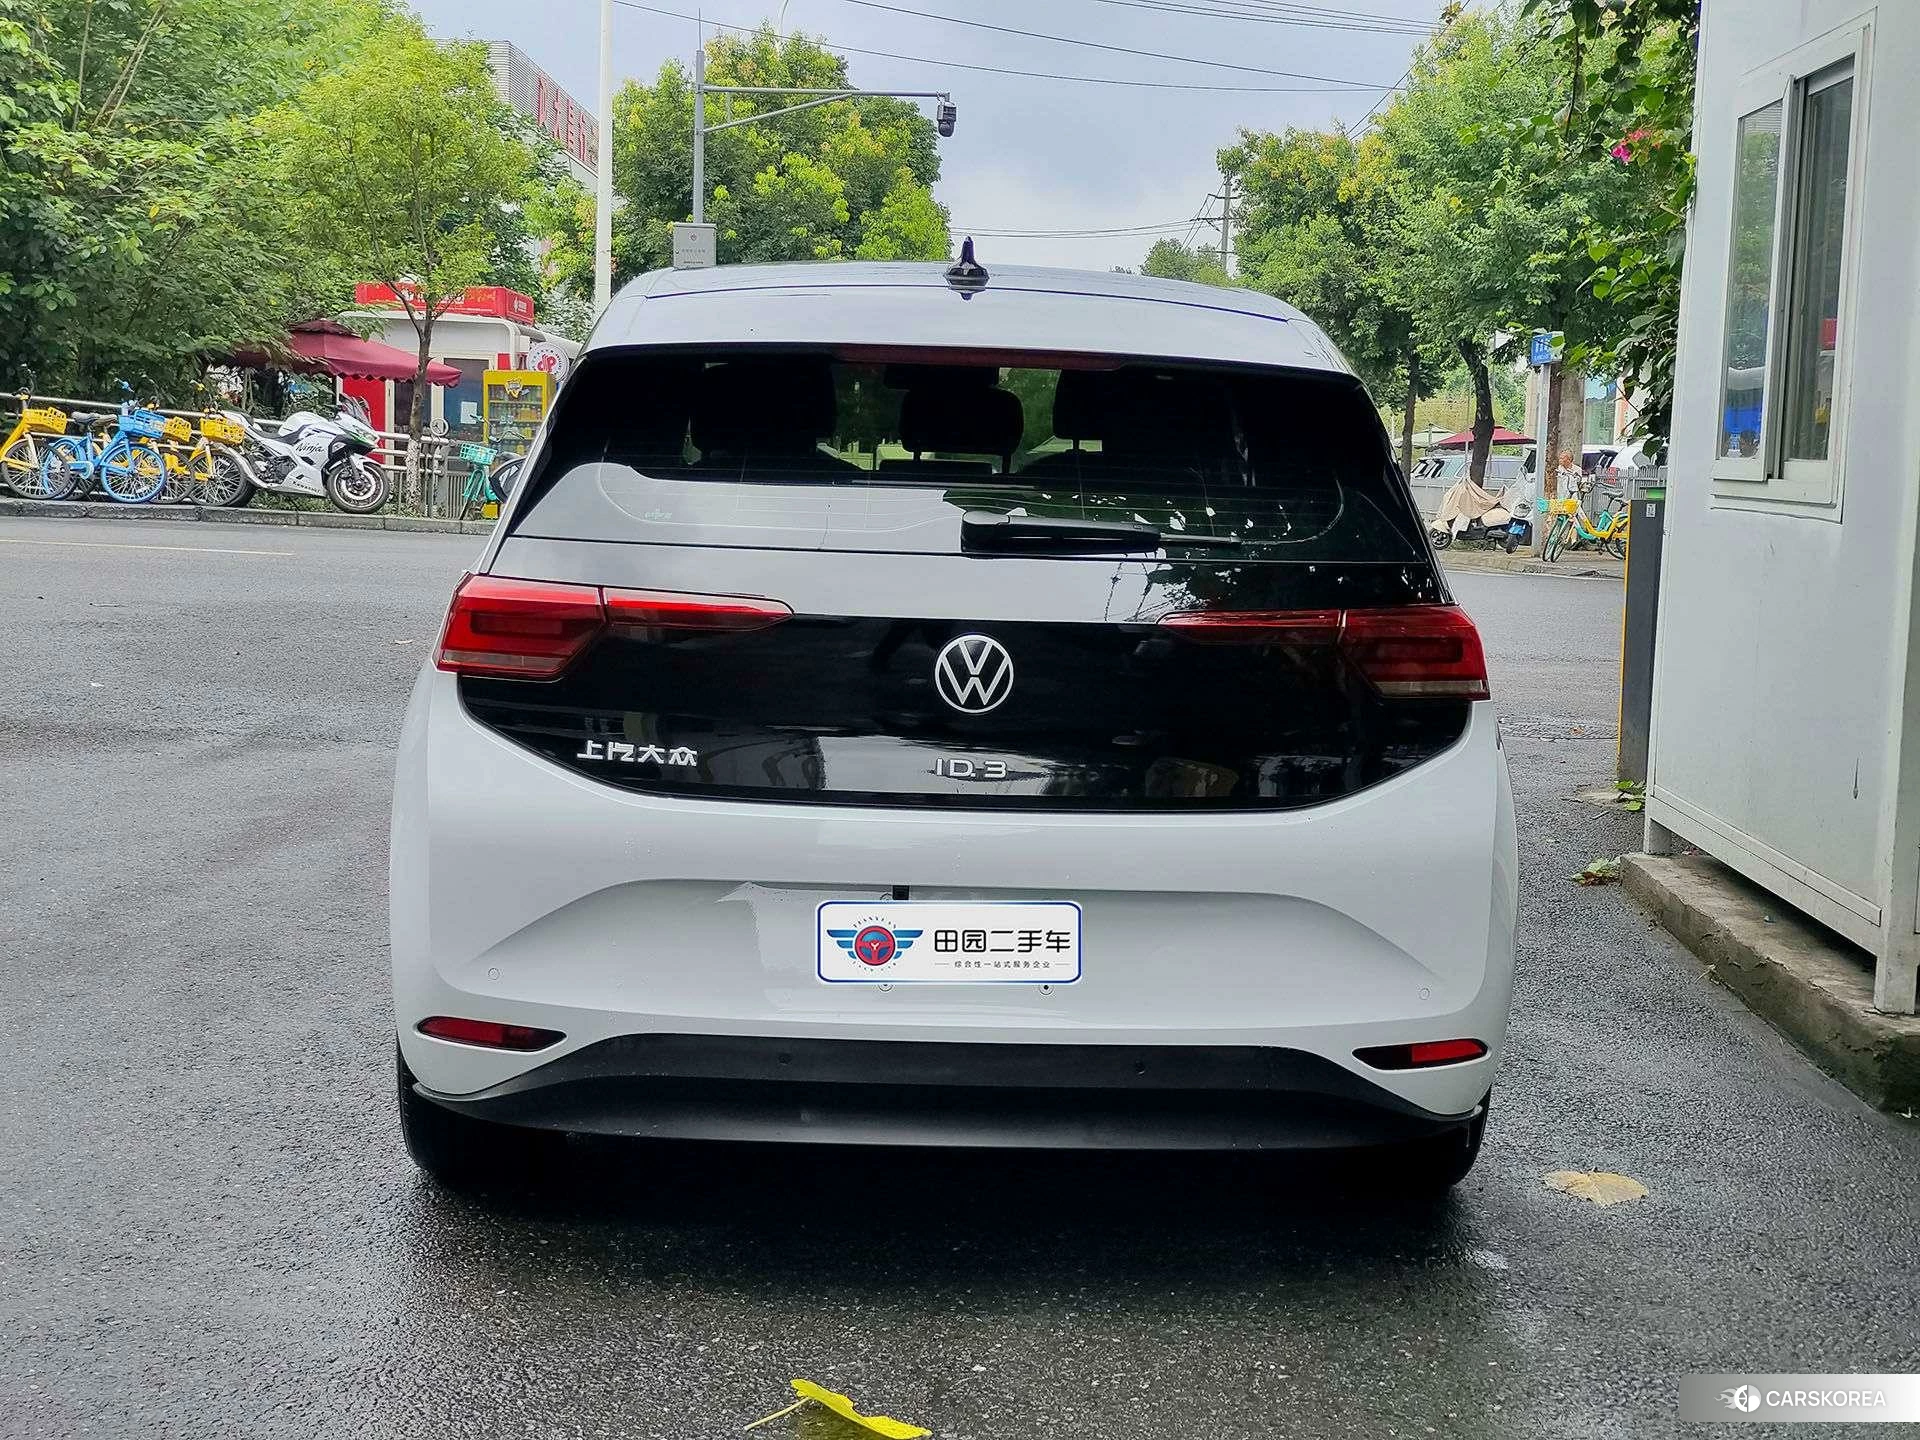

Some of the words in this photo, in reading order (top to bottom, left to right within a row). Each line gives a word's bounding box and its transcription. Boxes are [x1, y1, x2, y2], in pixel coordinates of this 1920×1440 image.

[295, 442, 325, 454] Ninja
[576, 739, 698, 767] 上汽大众
[934, 929, 1071, 953] 田园二手车
